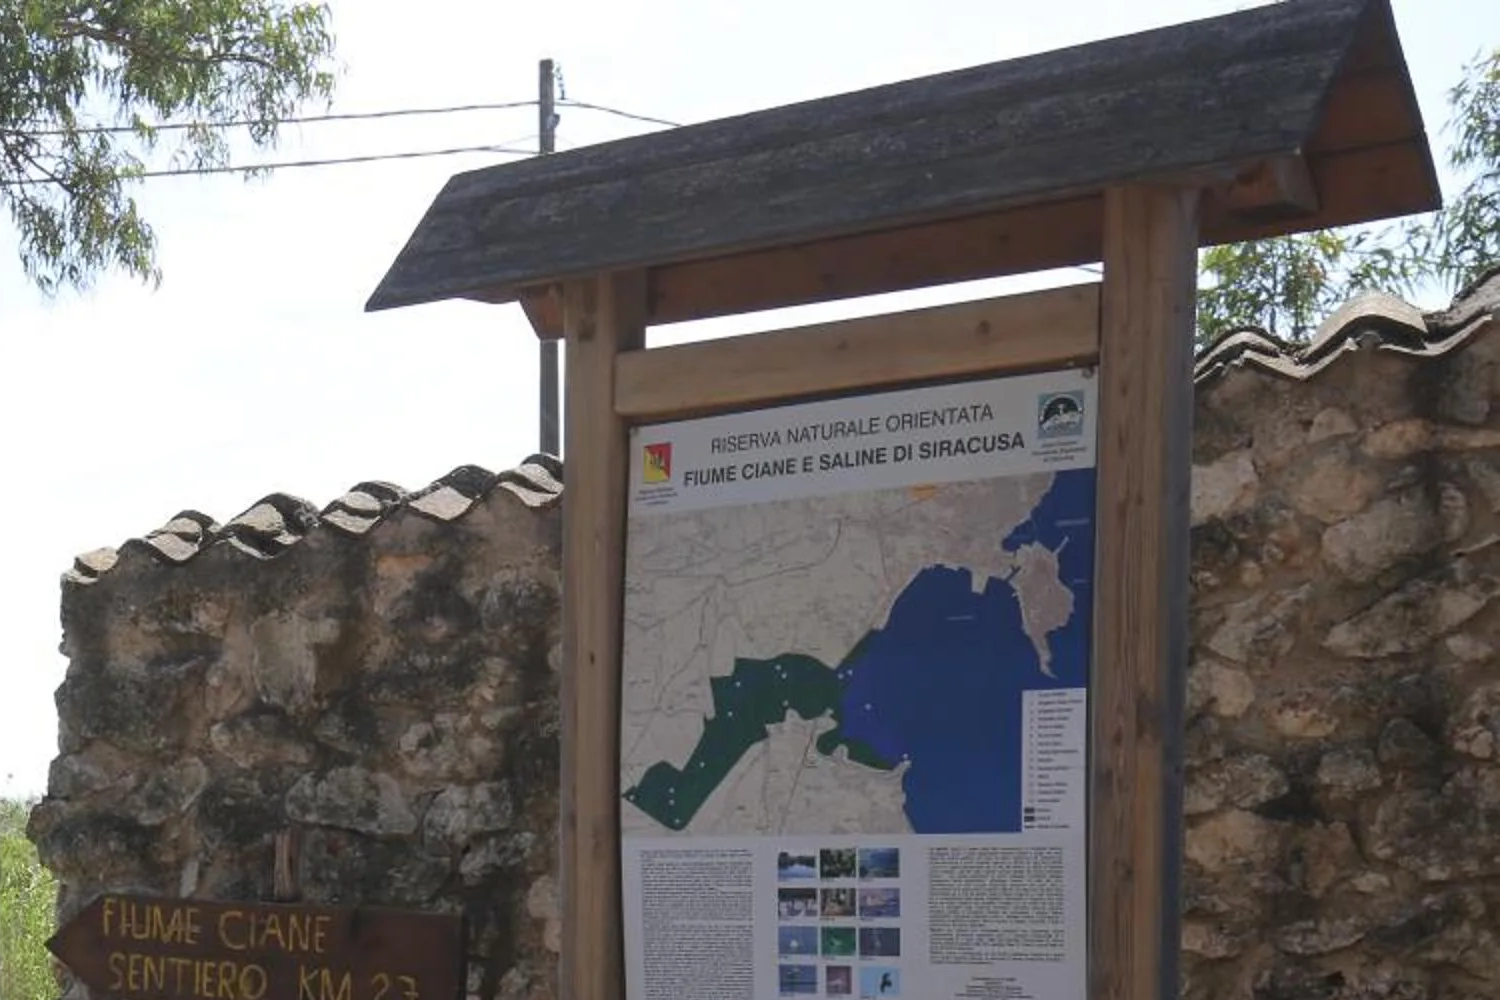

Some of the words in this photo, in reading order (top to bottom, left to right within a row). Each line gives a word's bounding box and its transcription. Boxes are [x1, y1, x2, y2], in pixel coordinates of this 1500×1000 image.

[711, 431, 781, 454] RISERVA
[787, 416, 881, 443] NATURALE
[885, 403, 994, 432] ORIENTATA
[683, 465, 737, 487] FIUME
[741, 457, 797, 480] CIANE
[802, 455, 813, 473] E
[819, 447, 887, 471] SALINE
[893, 443, 913, 463] DI
[919, 431, 1025, 459] SIRACUSA
[103, 898, 200, 946] FIUME
[218, 910, 332, 954] CIANE
[108, 952, 268, 1000] SENTIERO
